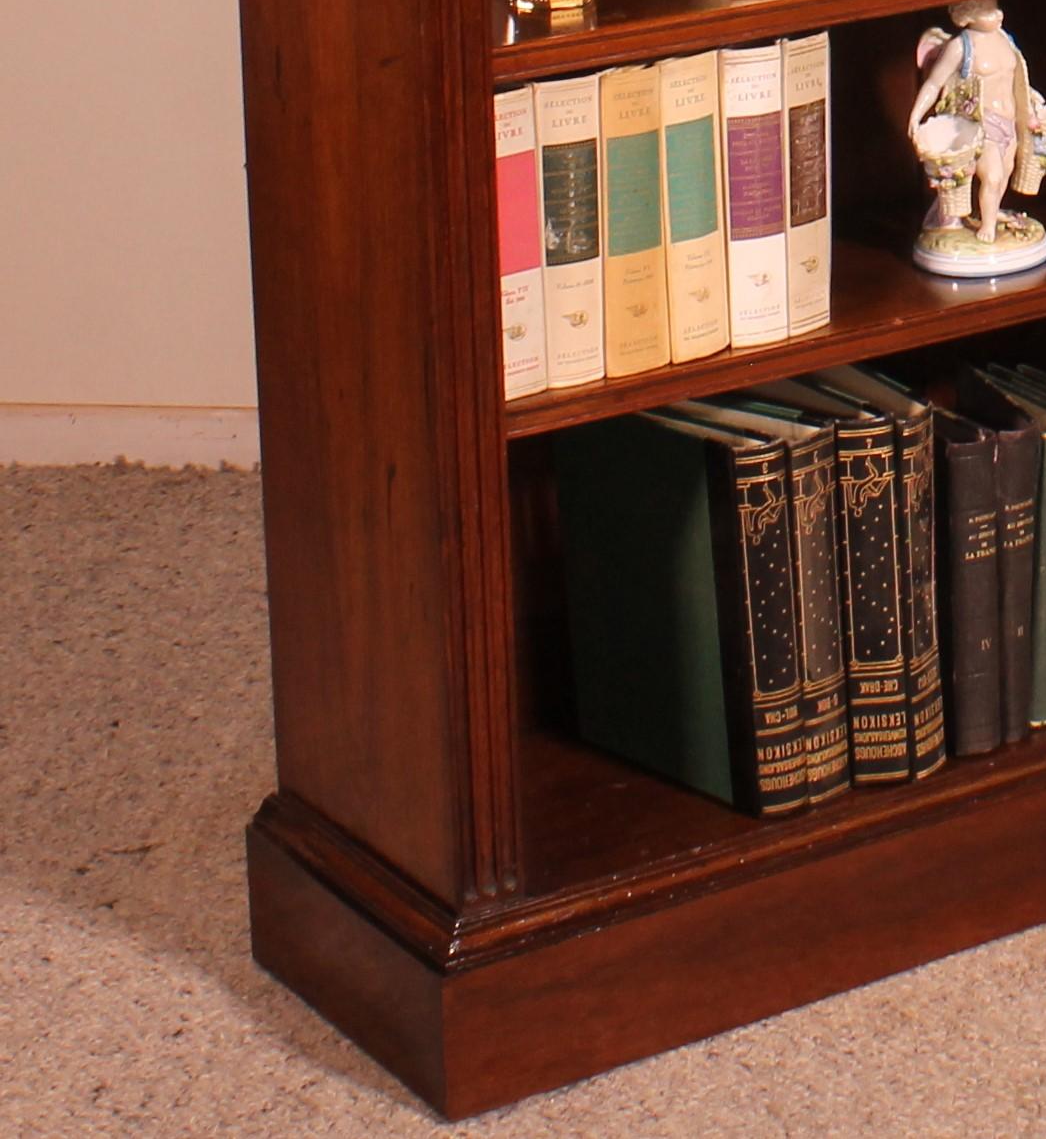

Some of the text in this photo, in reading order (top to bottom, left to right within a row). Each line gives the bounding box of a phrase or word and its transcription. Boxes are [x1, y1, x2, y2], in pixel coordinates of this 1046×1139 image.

[674, 92, 706, 108] LIVRE
[737, 89, 773, 102] LIVRE
[551, 114, 588, 129] LIVRE
[853, 711, 907, 730] LEKSIKON
[854, 742, 908, 760] ASCHEHOUGS
